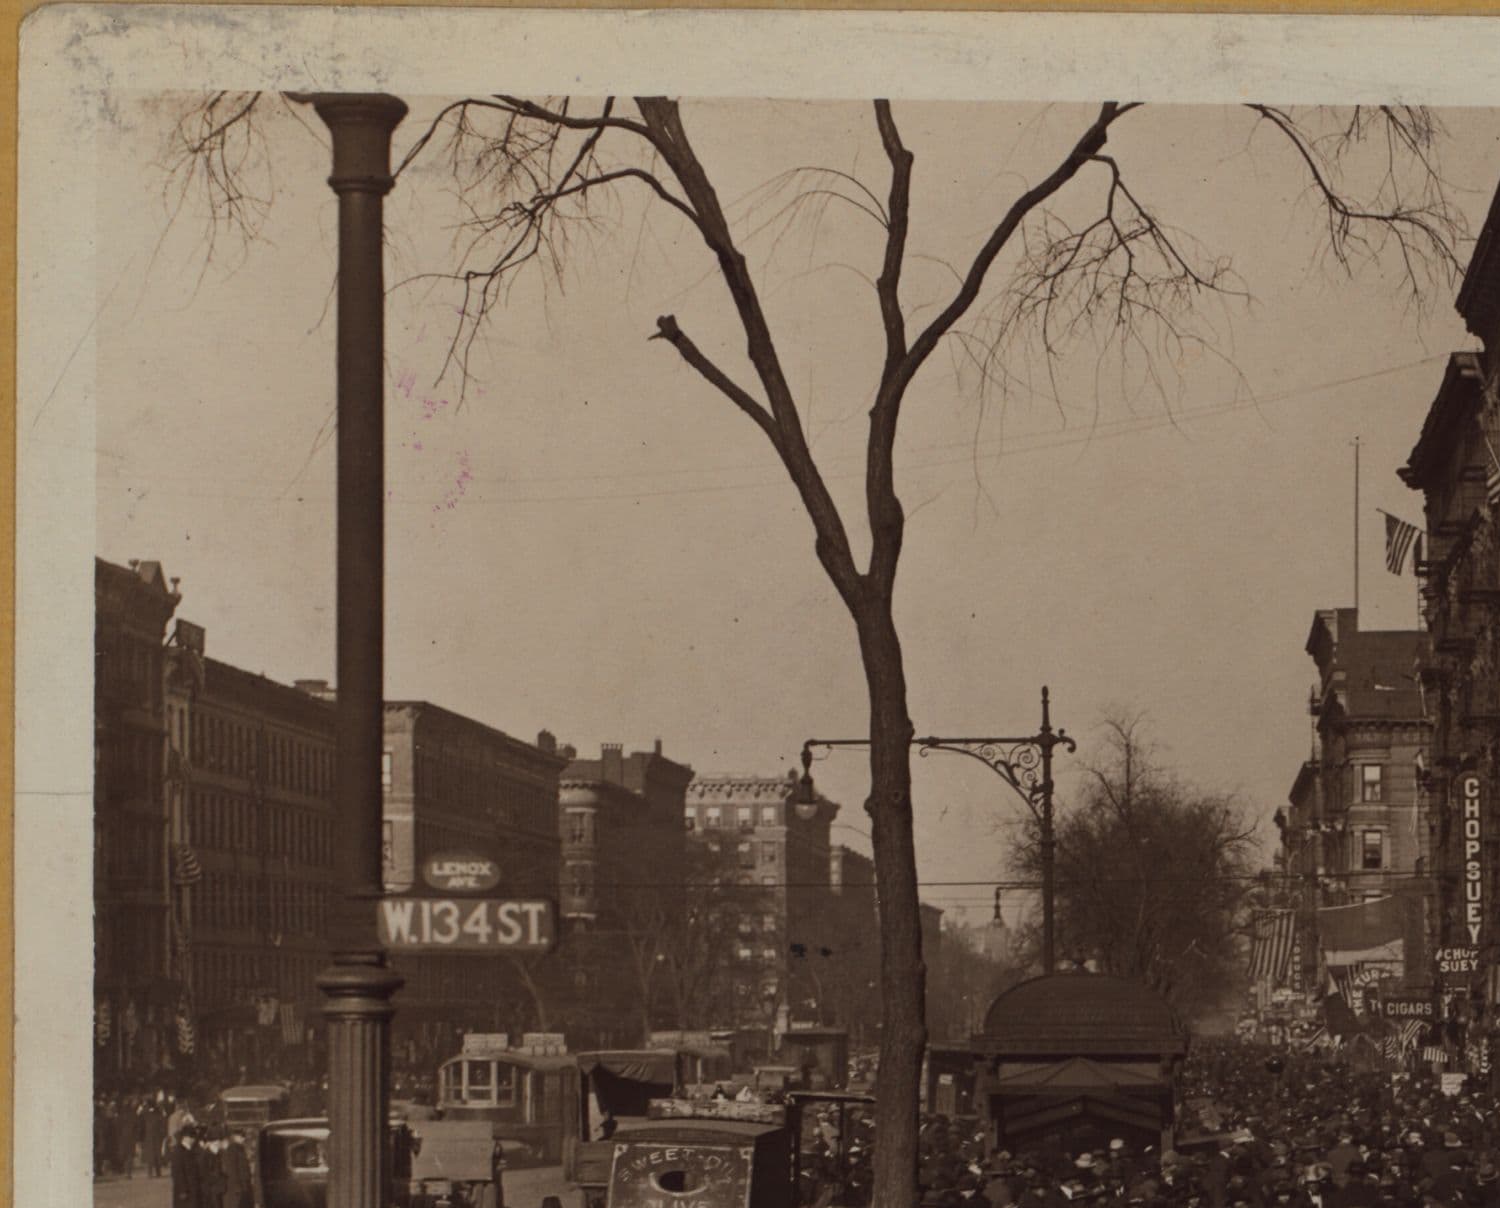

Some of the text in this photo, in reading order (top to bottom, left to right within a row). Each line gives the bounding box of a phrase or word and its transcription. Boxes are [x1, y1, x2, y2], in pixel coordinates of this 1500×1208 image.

[431, 861, 492, 876] LENOX
[1464, 778, 1483, 945] CHOP SUEY
[497, 902, 549, 944] ST.
[1439, 959, 1479, 972] SUEY
[1386, 1001, 1433, 1017] CIGARS
